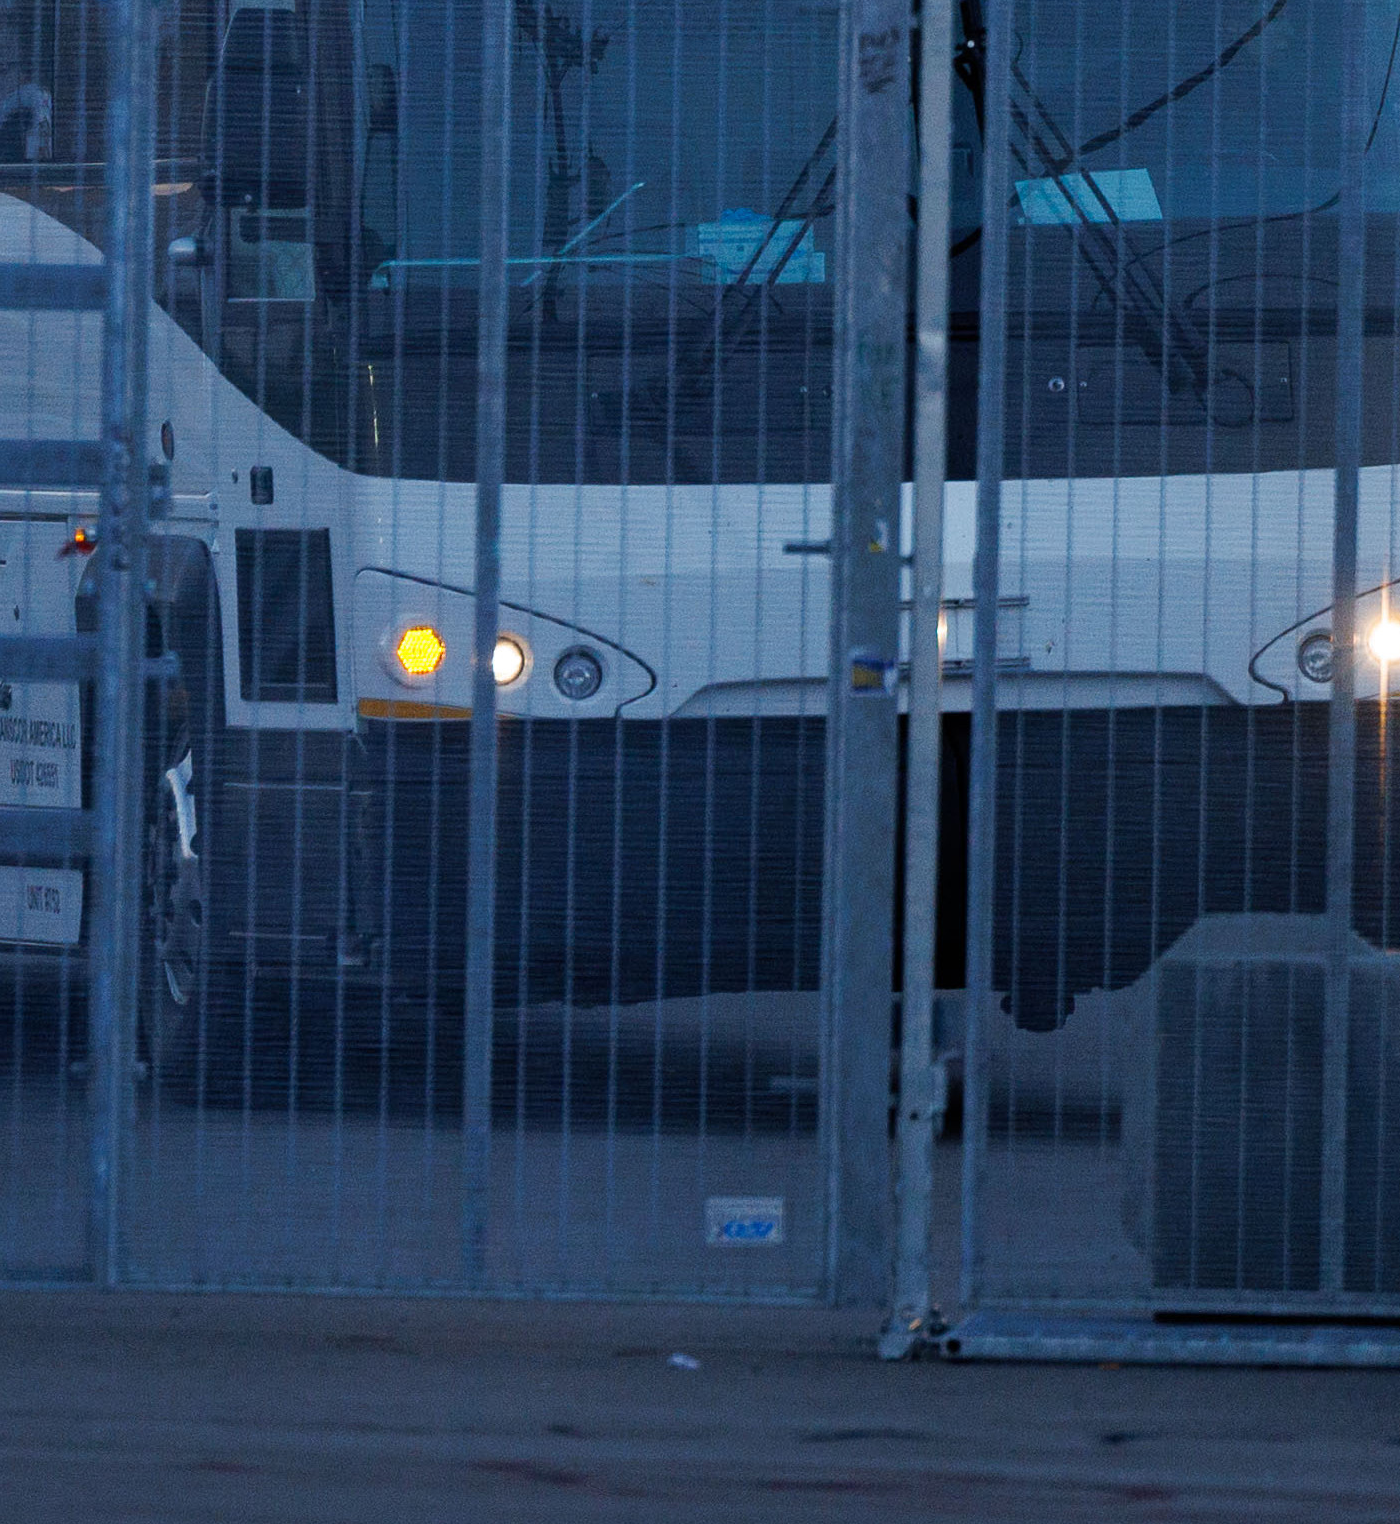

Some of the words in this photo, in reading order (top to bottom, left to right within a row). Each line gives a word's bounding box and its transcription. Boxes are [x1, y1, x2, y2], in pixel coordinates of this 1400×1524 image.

[29, 719, 61, 748] AMERICA
[62, 722, 76, 750] LLC
[10, 759, 34, 786] USDOT
[27, 885, 43, 911] UNIT
